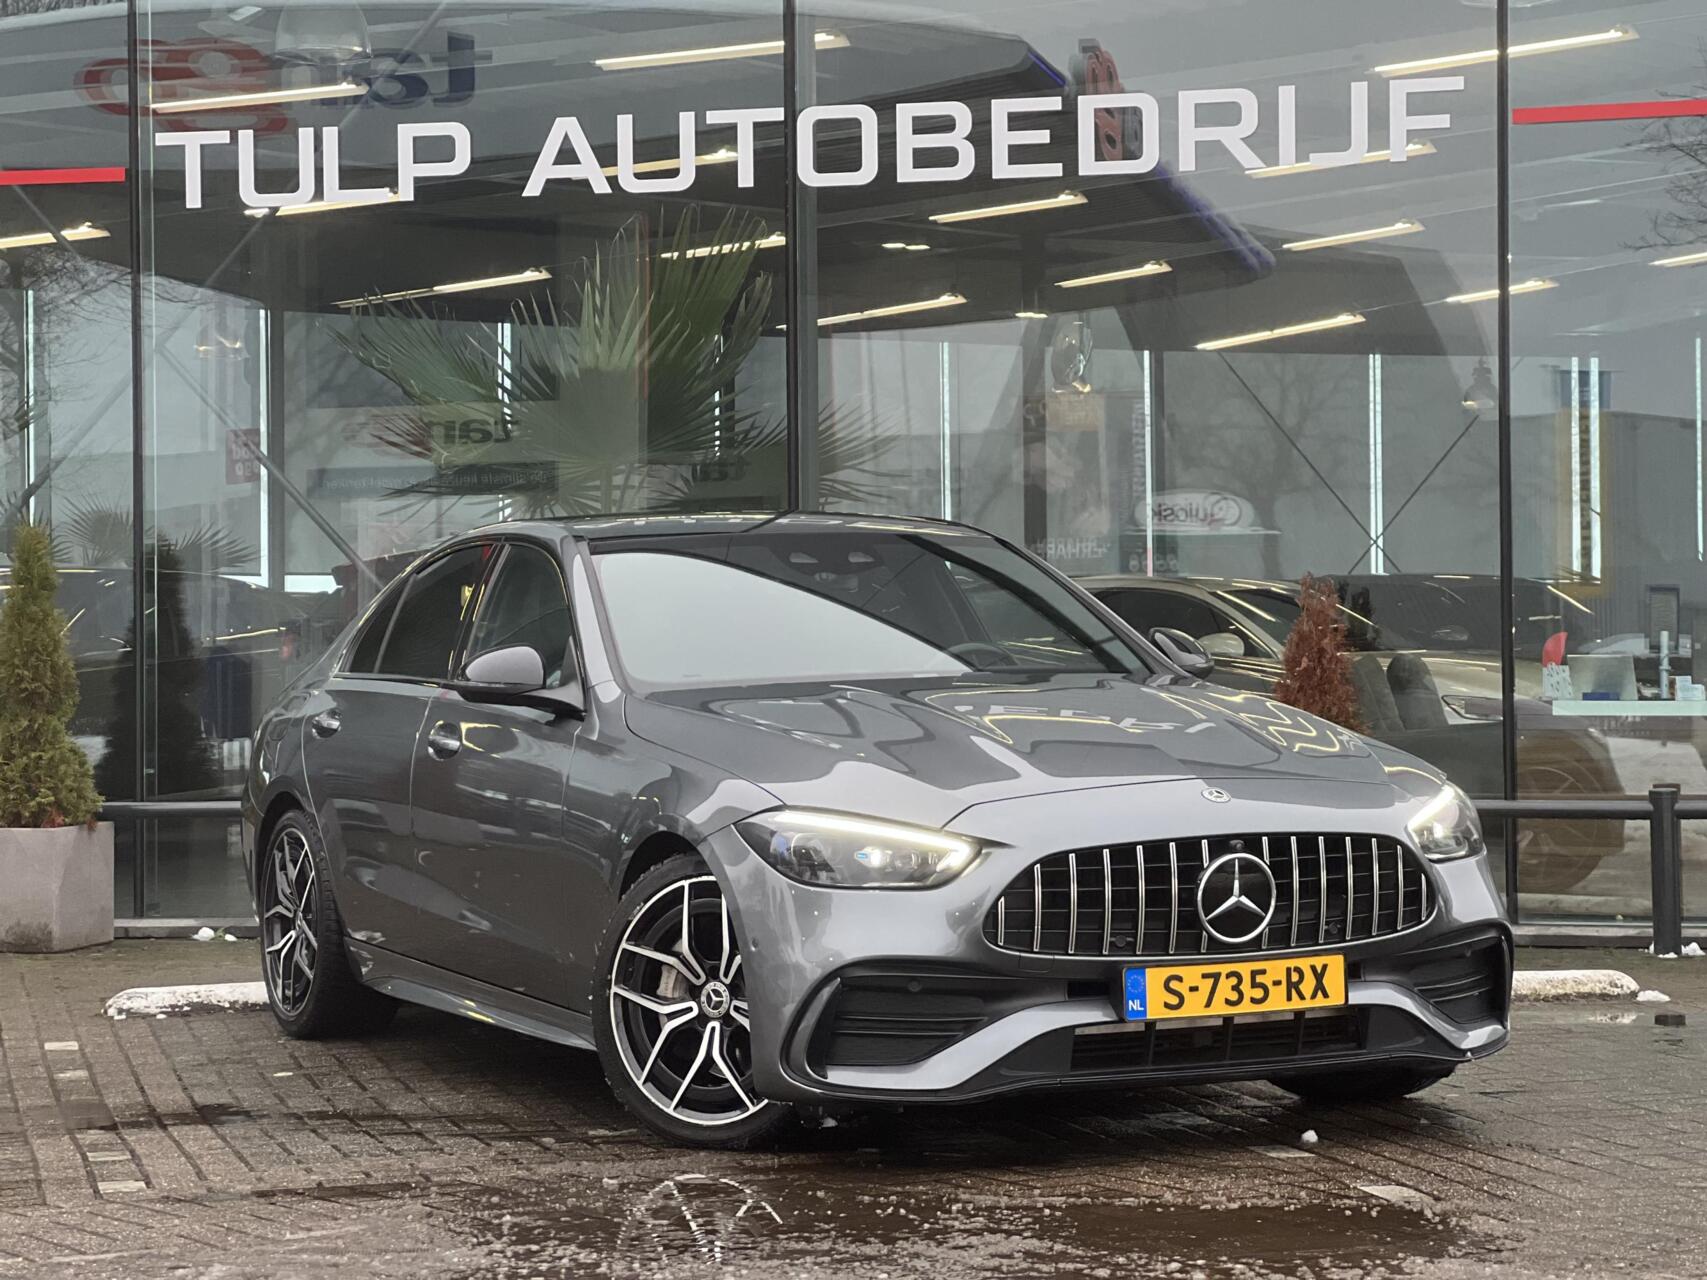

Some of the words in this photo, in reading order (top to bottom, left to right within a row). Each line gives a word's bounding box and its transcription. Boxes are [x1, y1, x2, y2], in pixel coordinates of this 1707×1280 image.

[155, 121, 471, 208] TULP
[521, 76, 1464, 196] AUTOBEDRIJF
[1128, 999, 1144, 1011] NL
[1163, 963, 1330, 1011] S-735-RX
